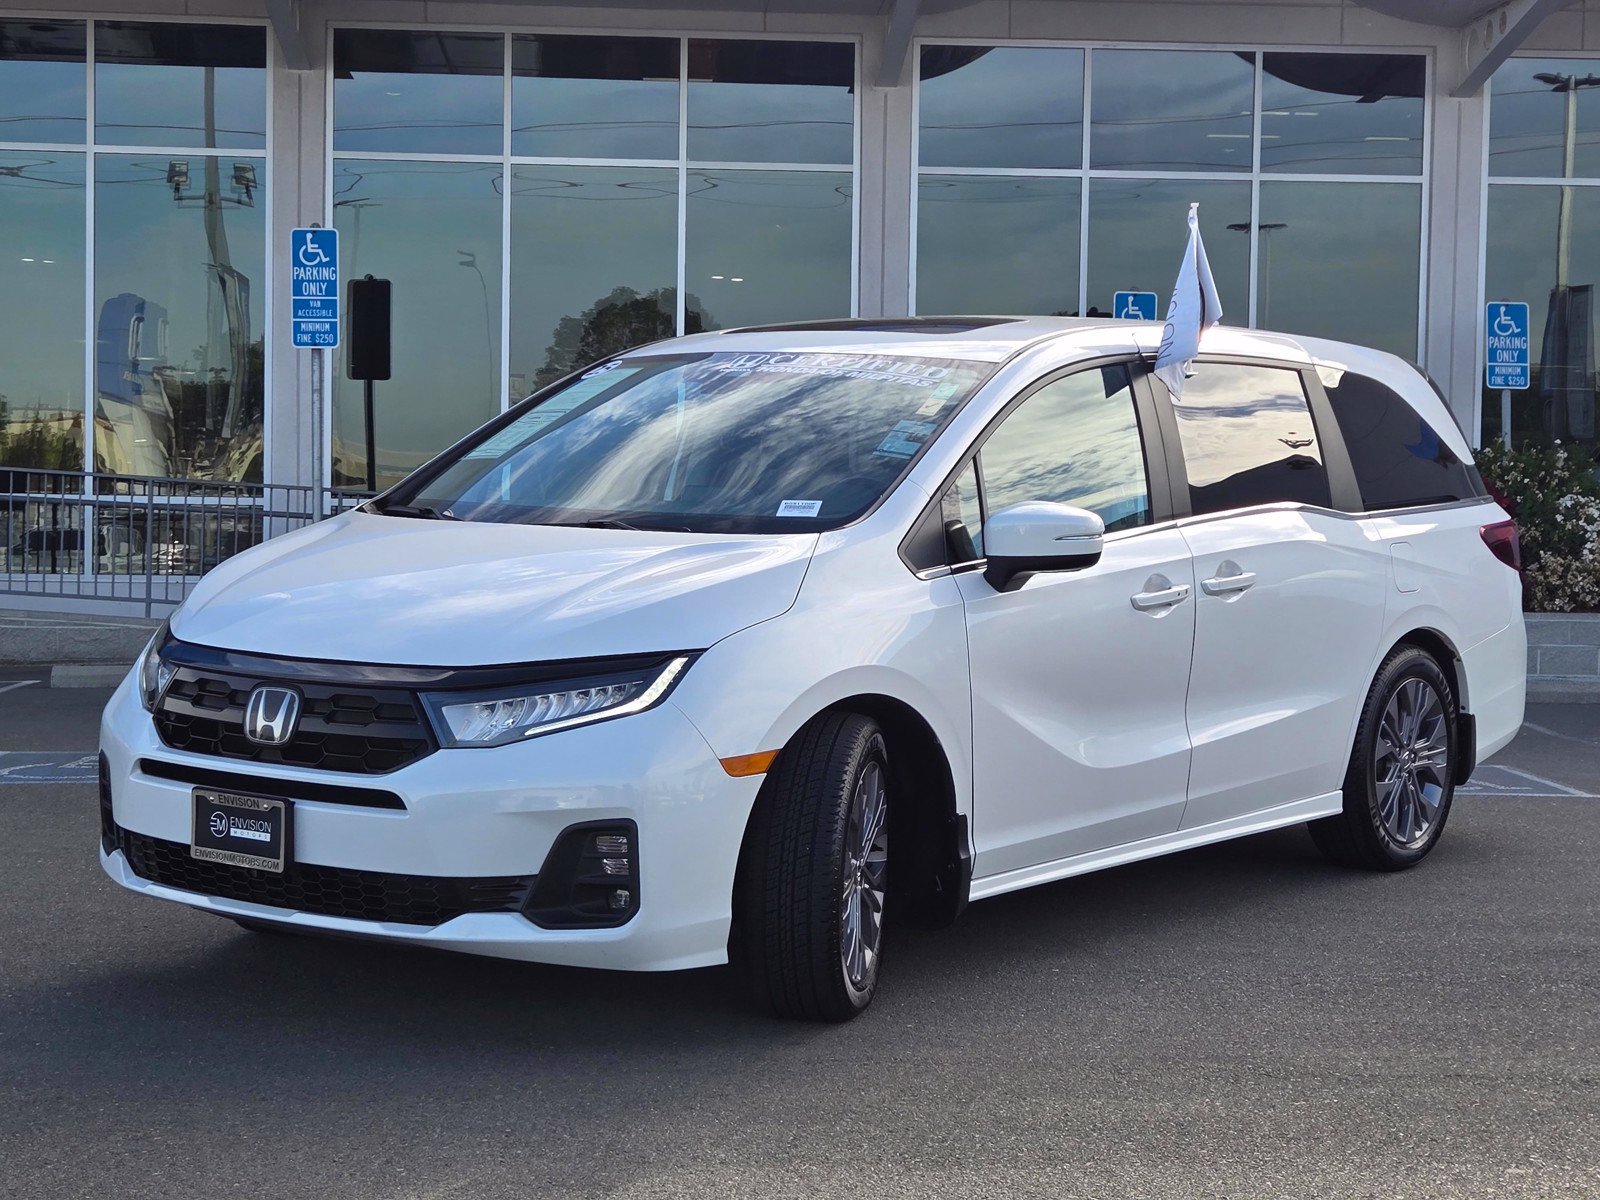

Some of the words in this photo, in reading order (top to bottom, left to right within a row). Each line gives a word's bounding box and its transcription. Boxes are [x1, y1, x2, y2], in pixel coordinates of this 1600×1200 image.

[293, 266, 336, 281] PARKING
[302, 282, 328, 296] ONLY
[309, 300, 321, 308] VAN
[297, 309, 333, 317] ACCESSIBLE
[300, 322, 330, 332] MINIMUM
[296, 333, 312, 343] FINE
[315, 333, 334, 343] $250
[1489, 336, 1527, 349] PARKING
[1496, 350, 1519, 362] ONLY
[768, 354, 949, 378] CERTIFIED
[1494, 366, 1521, 375] MINIMUM
[756, 366, 818, 374] HONDA
[845, 371, 936, 387] MILPITAS
[1491, 375, 1505, 385] FINE
[1508, 376, 1525, 385] $250
[218, 794, 260, 809] ENVISION
[230, 816, 272, 833] ENVISION
[233, 830, 268, 840] MOTORS
[194, 848, 280, 870] ENVISIONMOTORS.COM
